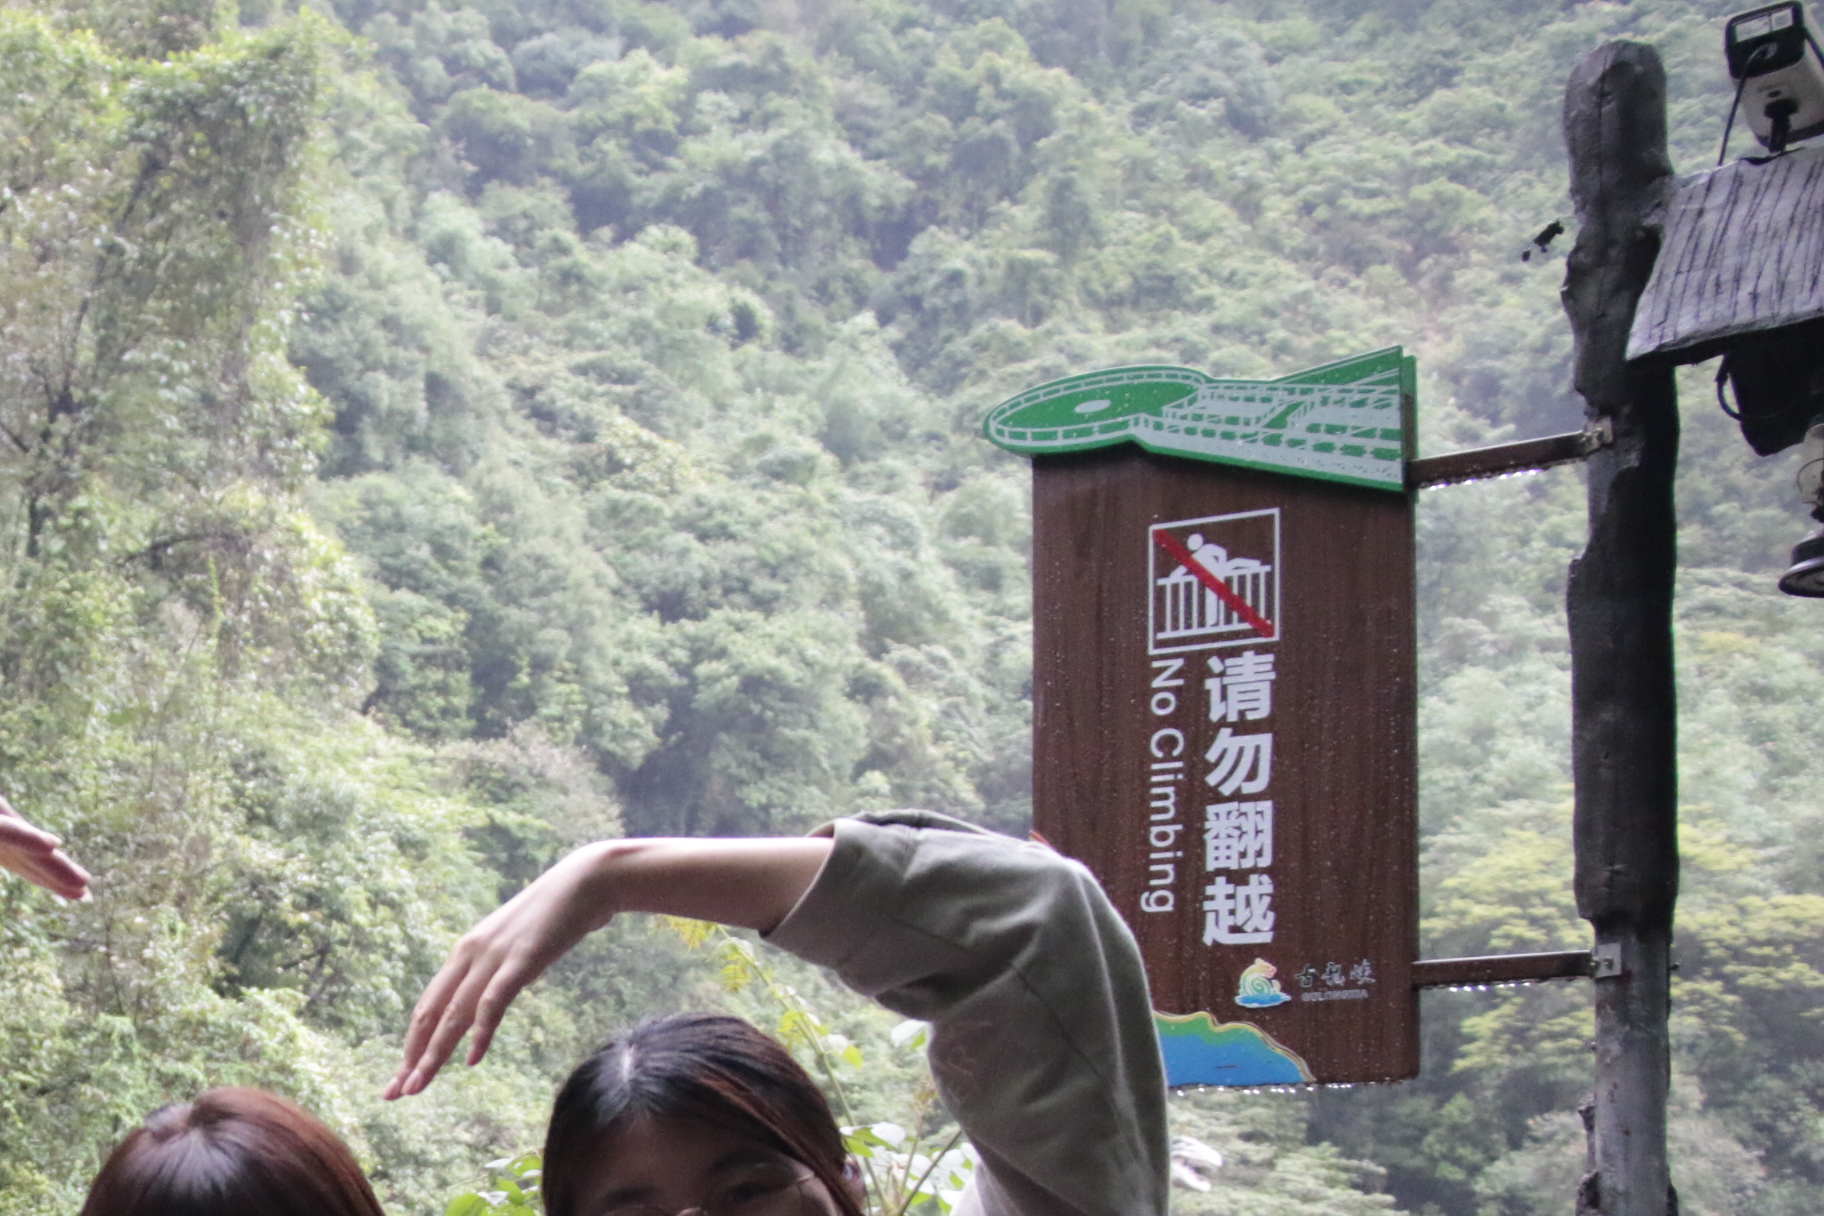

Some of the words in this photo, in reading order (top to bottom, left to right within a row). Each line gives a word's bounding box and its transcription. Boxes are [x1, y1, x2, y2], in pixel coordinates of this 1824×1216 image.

[1150, 657, 1184, 716] No
[1141, 727, 1184, 913] Climbing
[1202, 651, 1276, 947] 请勿翻越
